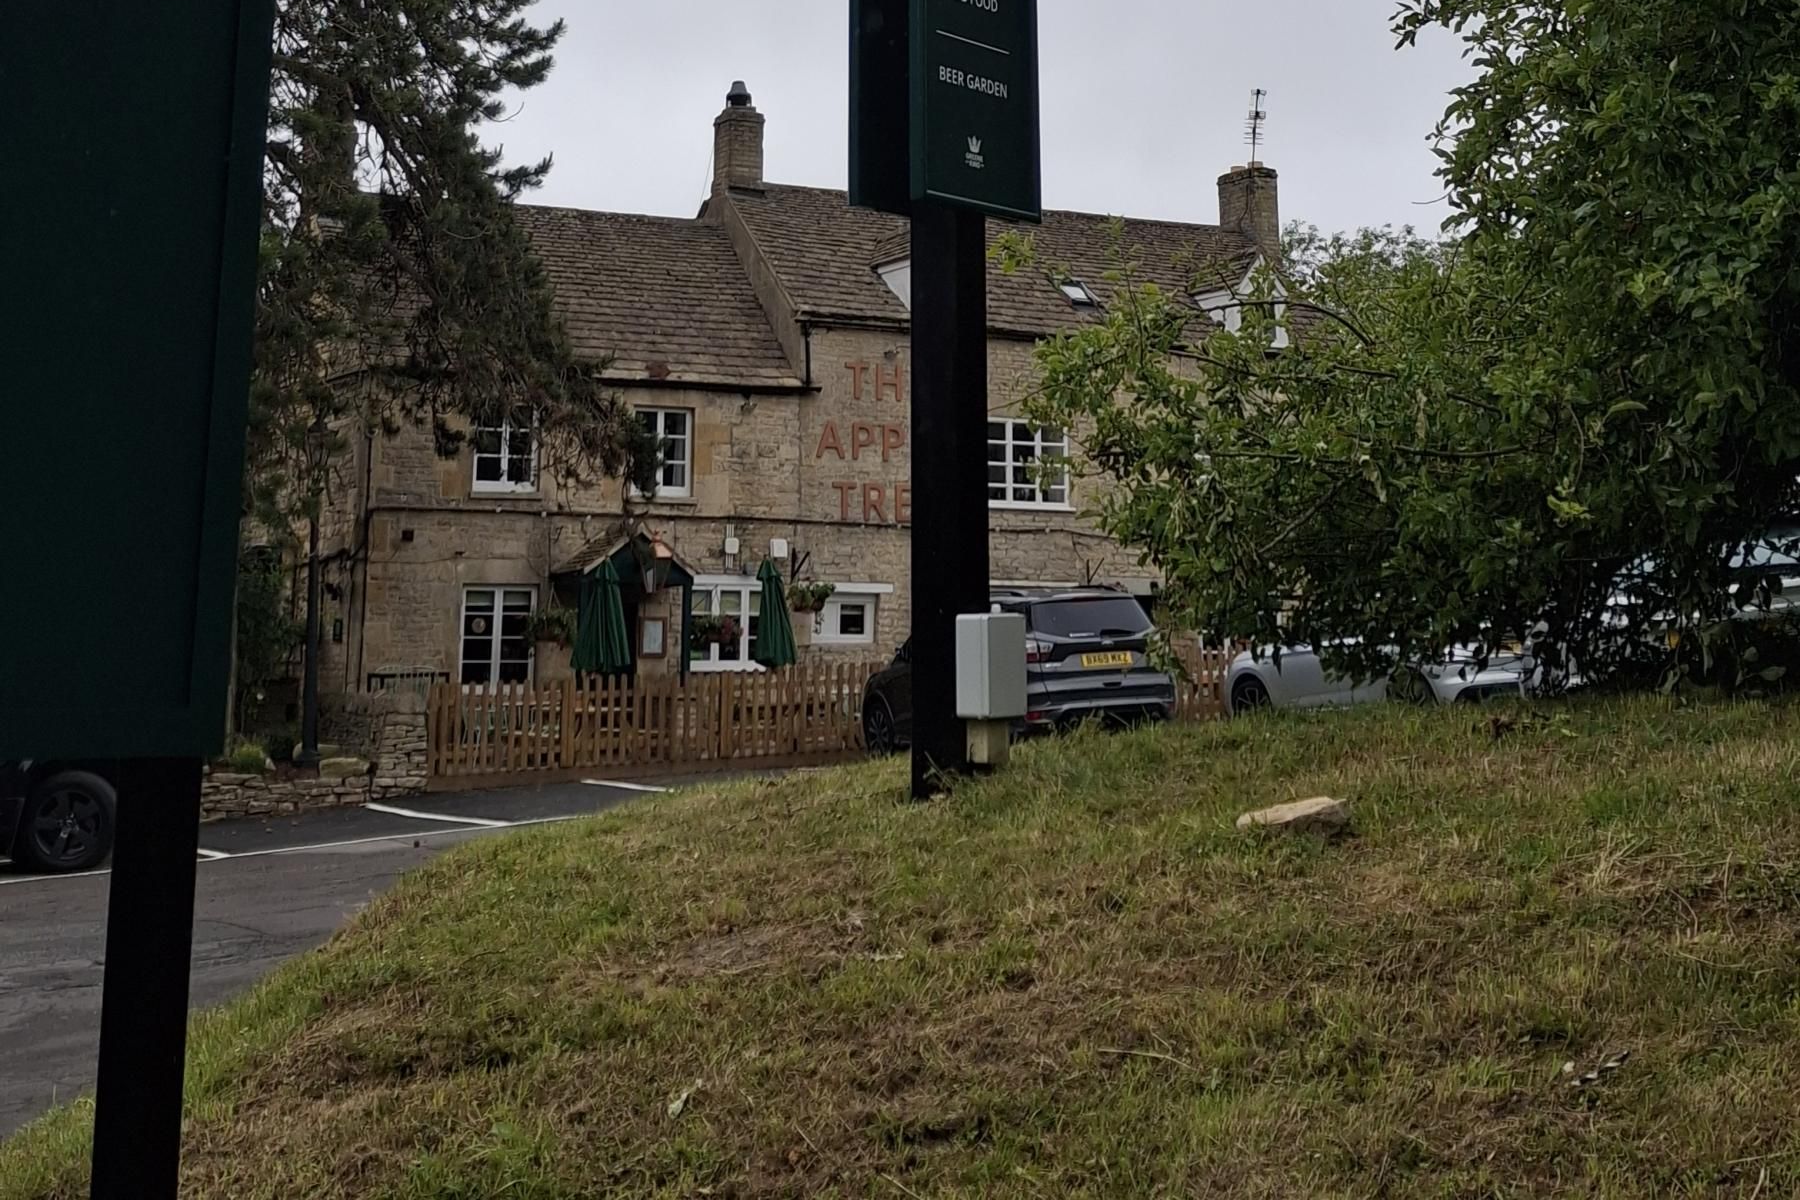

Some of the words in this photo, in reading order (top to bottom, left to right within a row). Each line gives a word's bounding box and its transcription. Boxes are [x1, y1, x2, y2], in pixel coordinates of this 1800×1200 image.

[939, 65, 965, 87] BEER
[966, 74, 1008, 99] GARDEN
[845, 362, 903, 402] TH
[816, 421, 906, 462] APP
[832, 481, 911, 522] TRE
